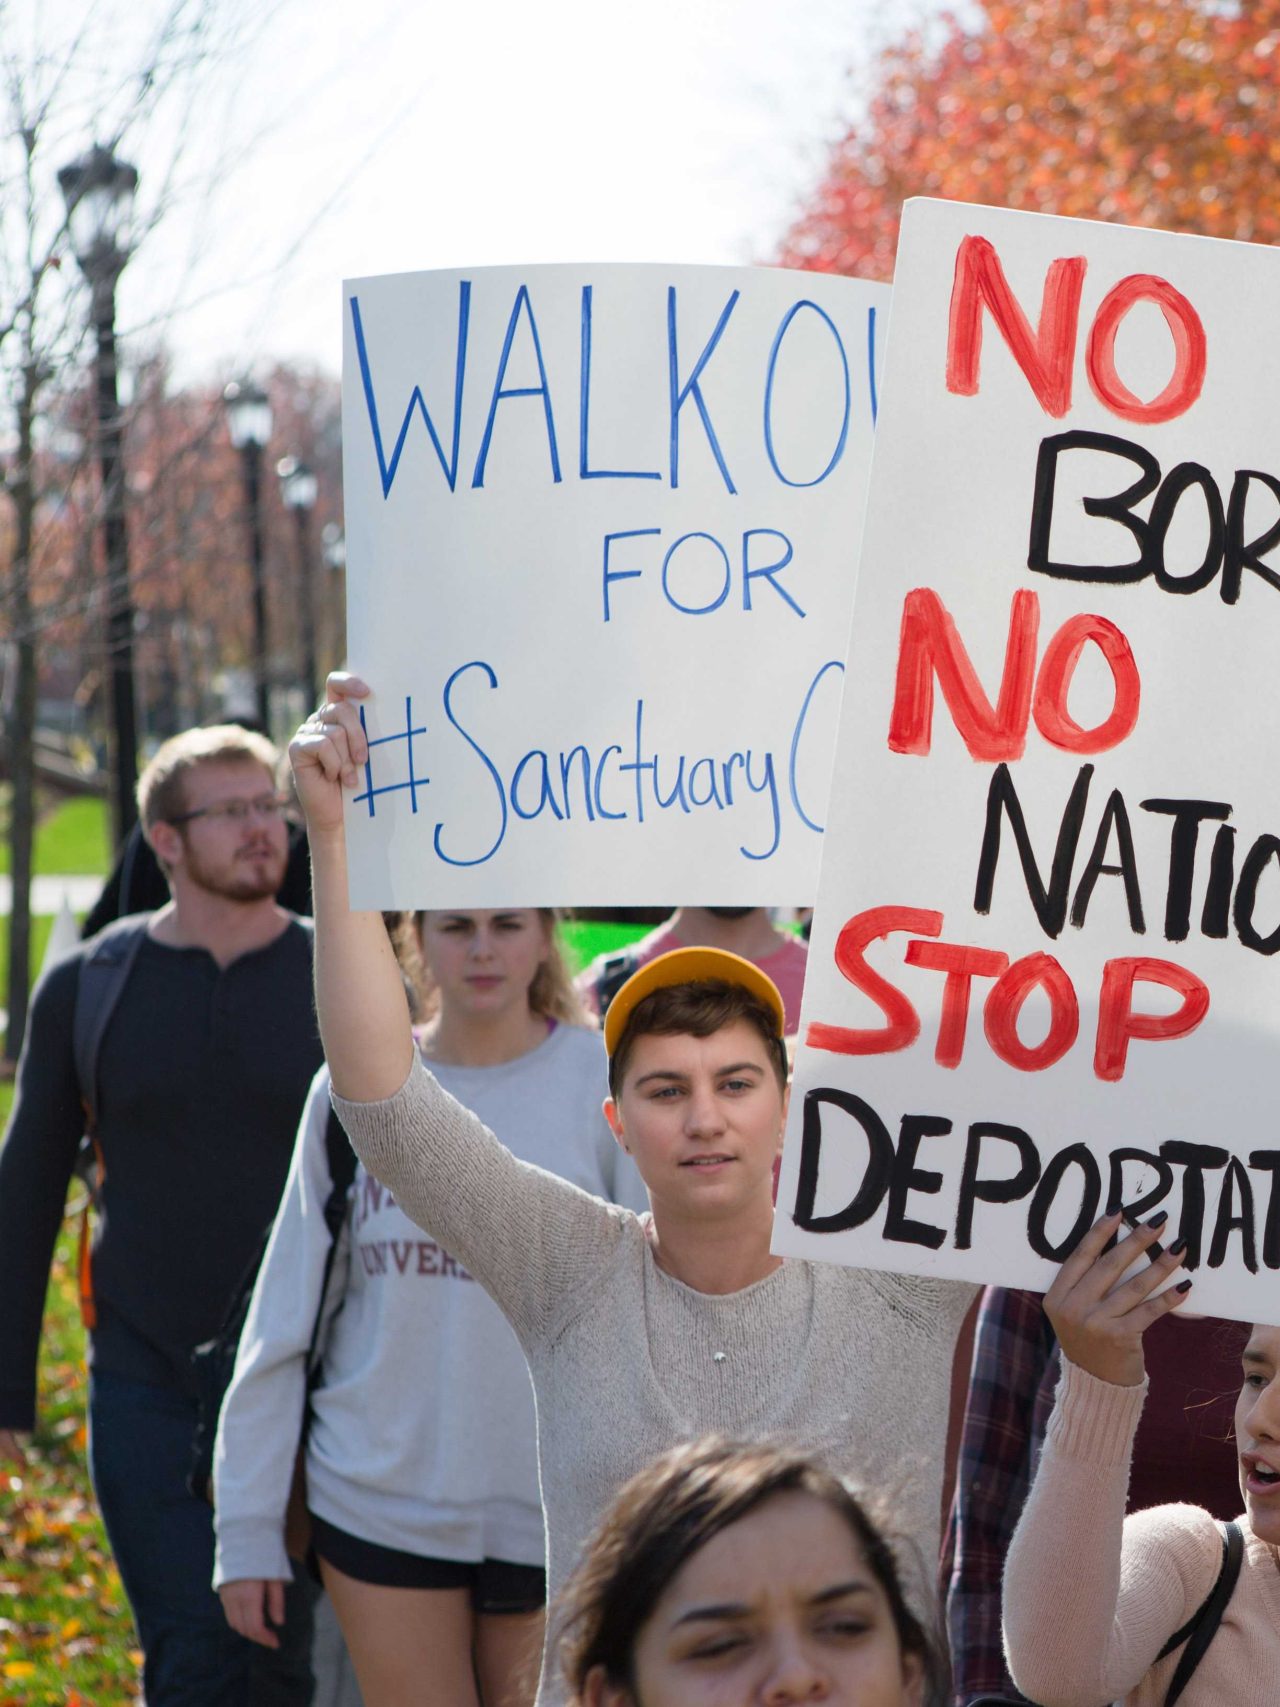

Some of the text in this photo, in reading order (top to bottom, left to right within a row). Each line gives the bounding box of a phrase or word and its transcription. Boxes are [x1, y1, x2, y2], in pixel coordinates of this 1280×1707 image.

[945, 234, 1207, 425] NO
[602, 527, 806, 622] FOR
[887, 587, 1142, 764] NO
[805, 905, 1210, 1082] STOP
